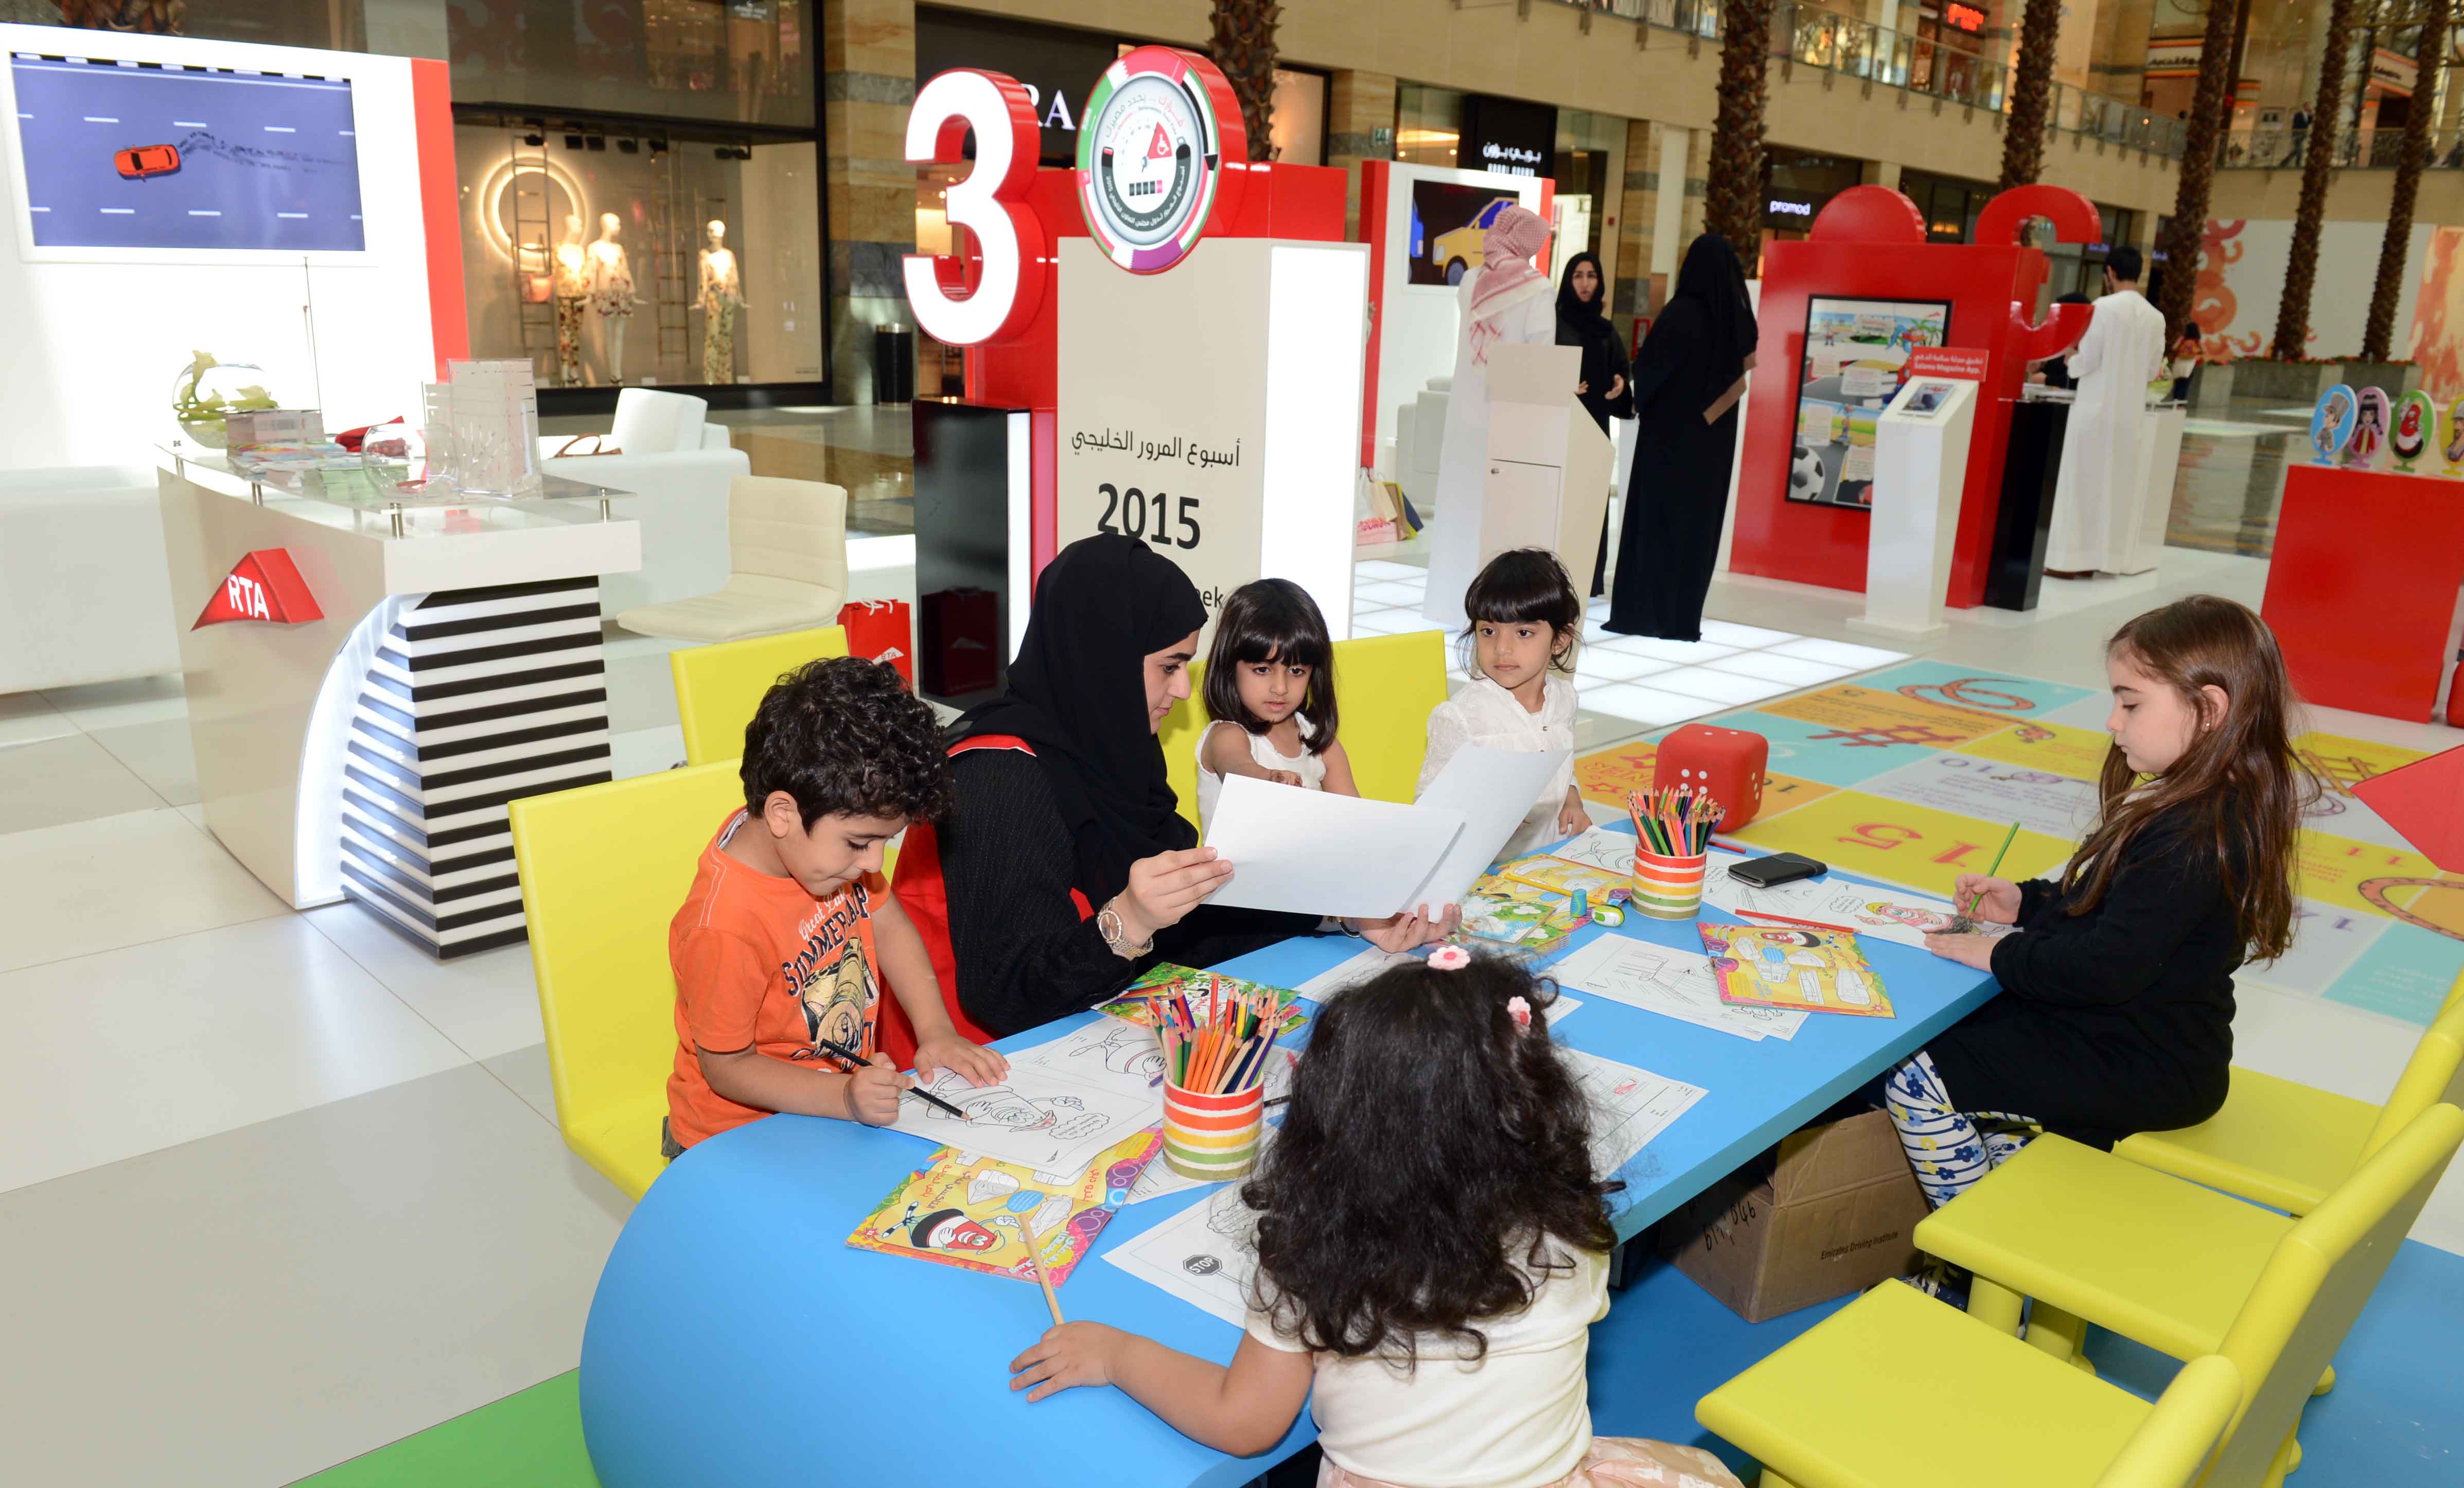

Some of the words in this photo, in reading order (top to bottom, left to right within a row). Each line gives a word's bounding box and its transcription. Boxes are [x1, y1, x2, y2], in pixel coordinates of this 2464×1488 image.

[1769, 200, 1811, 216] promod
[1071, 427, 1133, 456] الخليجي
[1137, 436, 1182, 460] المرور
[1187, 437, 1241, 468] أسبوع
[1097, 482, 1201, 550] 2015
[227, 574, 270, 622] RTA
[798, 901, 826, 942] Great
[1820, 1245, 1850, 1260] Emirates
[1850, 1238, 1873, 1252] Driving
[1189, 1257, 1214, 1273] STOP
